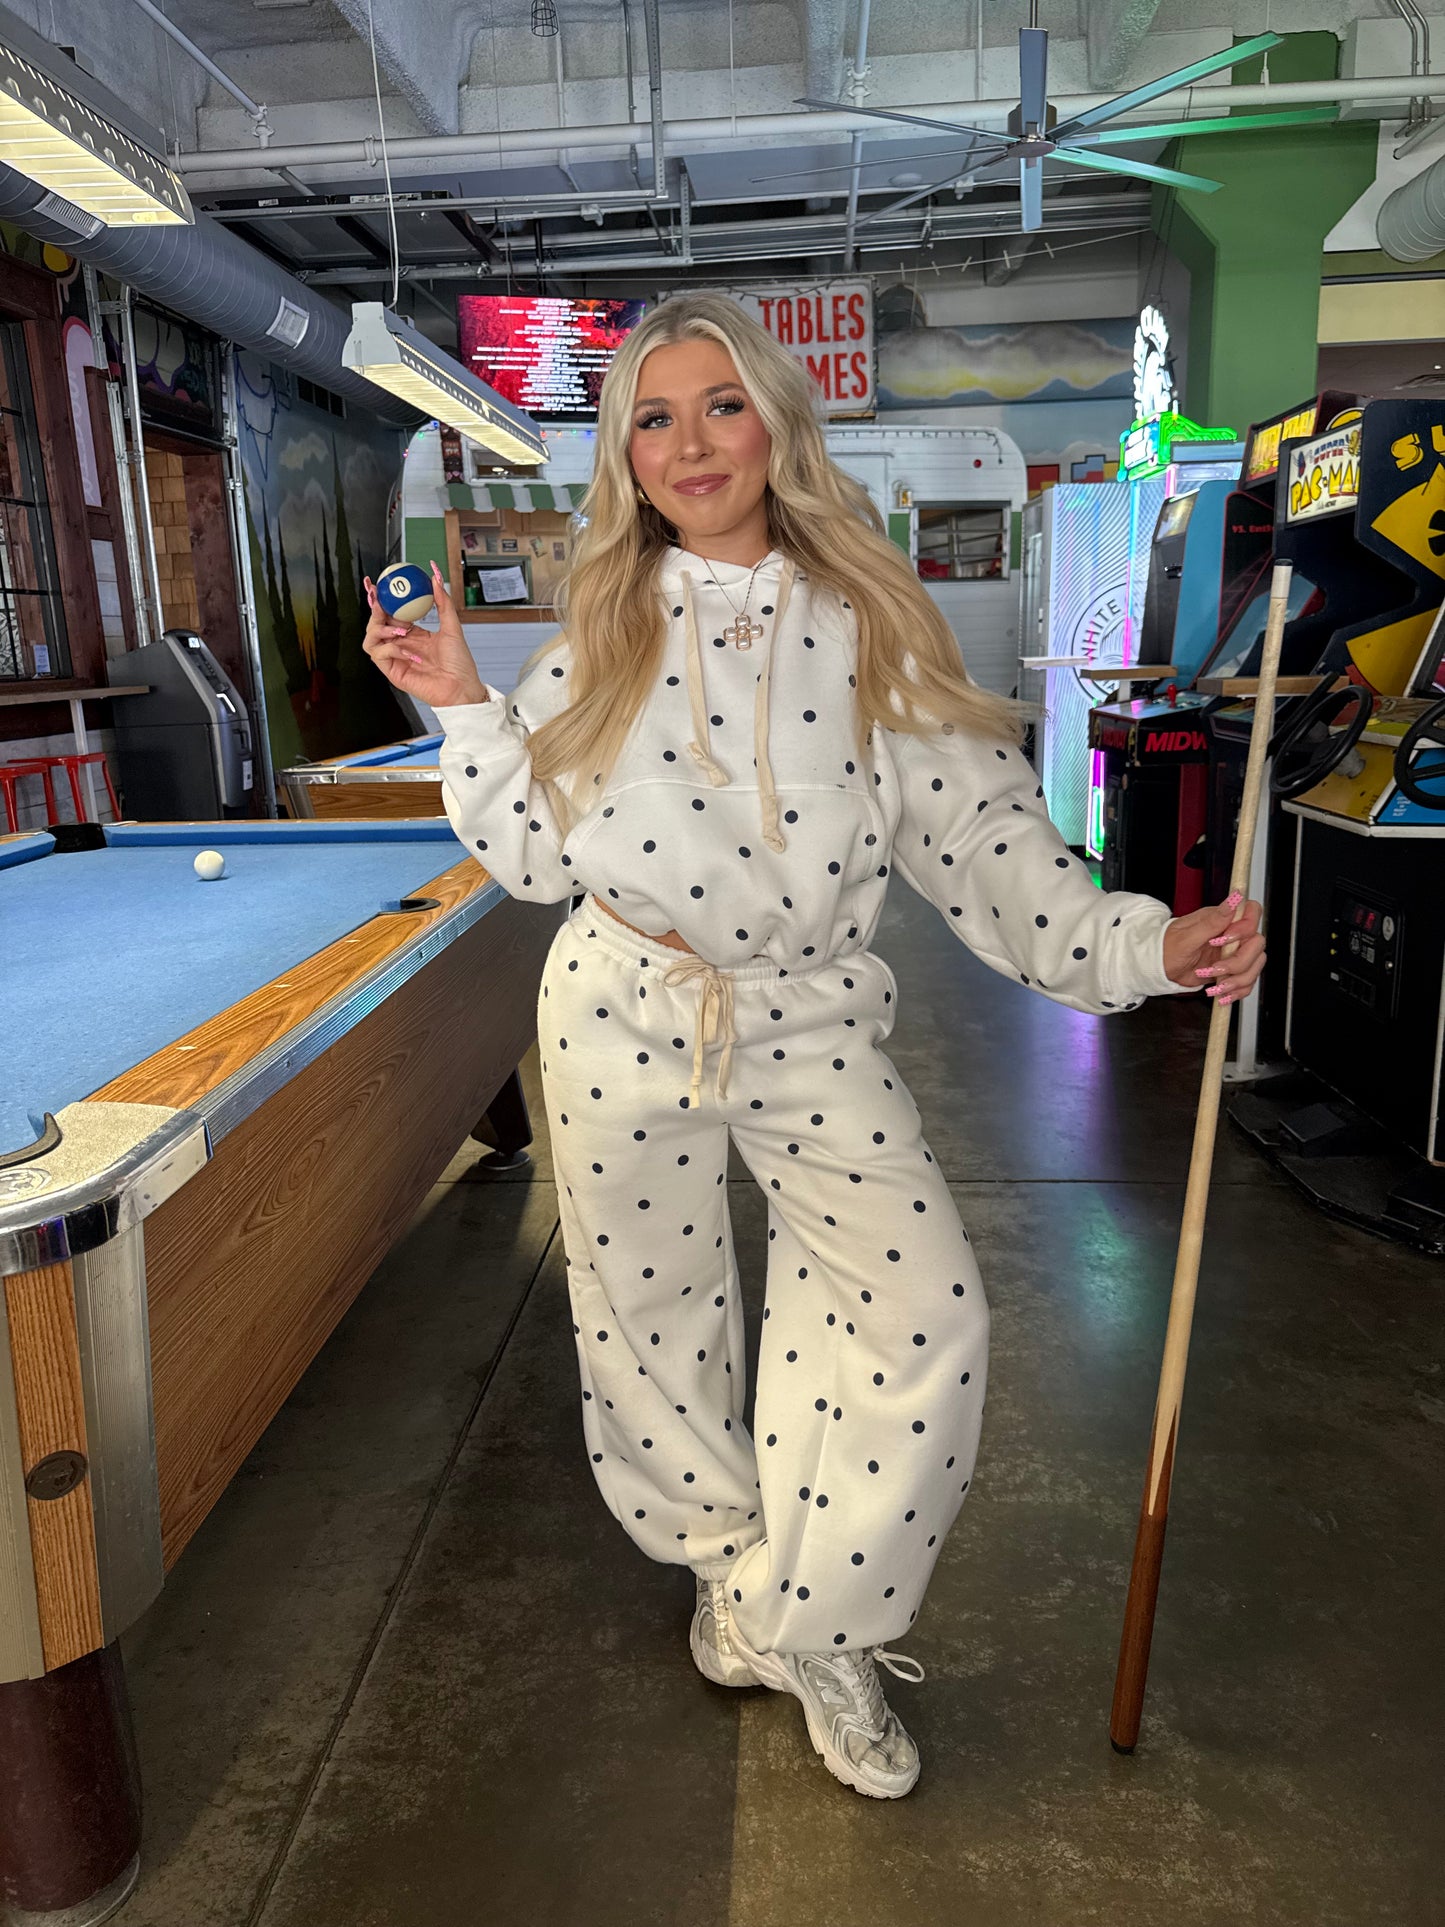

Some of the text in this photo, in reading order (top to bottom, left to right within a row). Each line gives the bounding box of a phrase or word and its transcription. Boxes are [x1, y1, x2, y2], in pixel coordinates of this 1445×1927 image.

[758, 293, 866, 345] TABLES
[796, 351, 868, 401] MES
[1291, 459, 1360, 516] PAC-MA
[393, 580, 406, 595] 10
